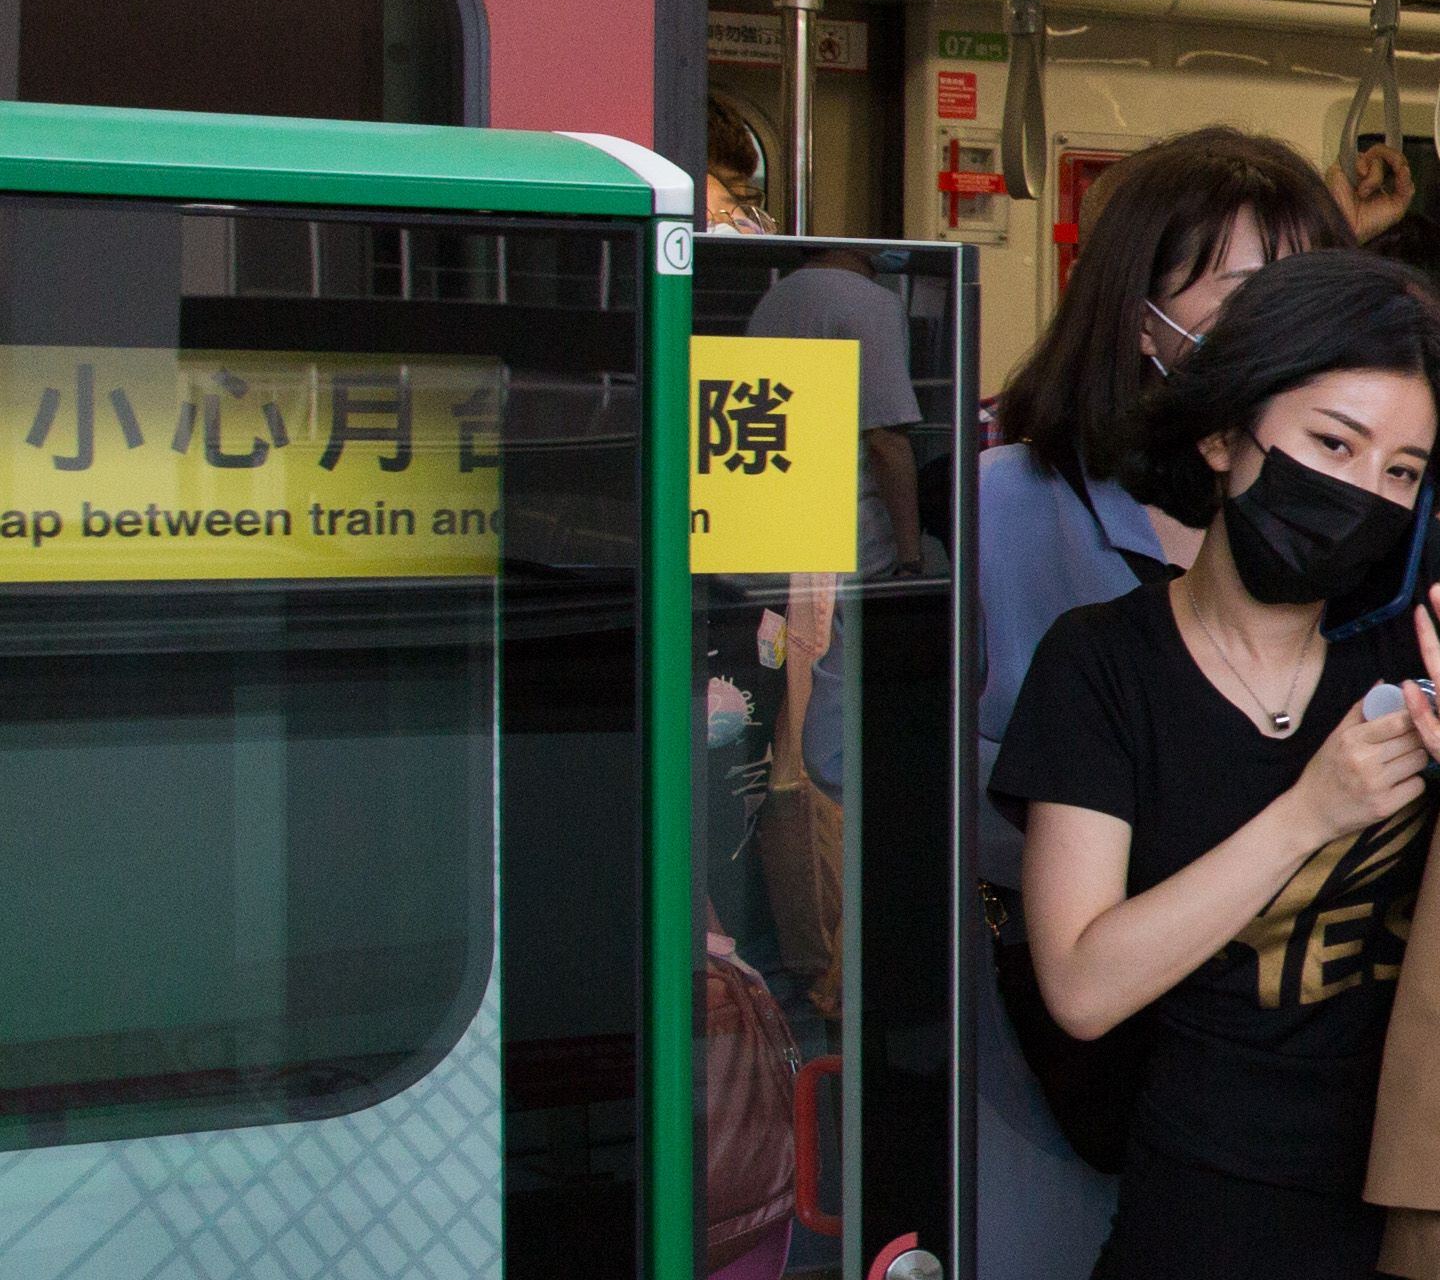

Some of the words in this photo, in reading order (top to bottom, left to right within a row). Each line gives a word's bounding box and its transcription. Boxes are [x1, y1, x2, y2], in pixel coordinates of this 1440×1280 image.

[697, 378, 794, 475] 隙
[82, 502, 292, 538] between
[309, 501, 415, 537] train
